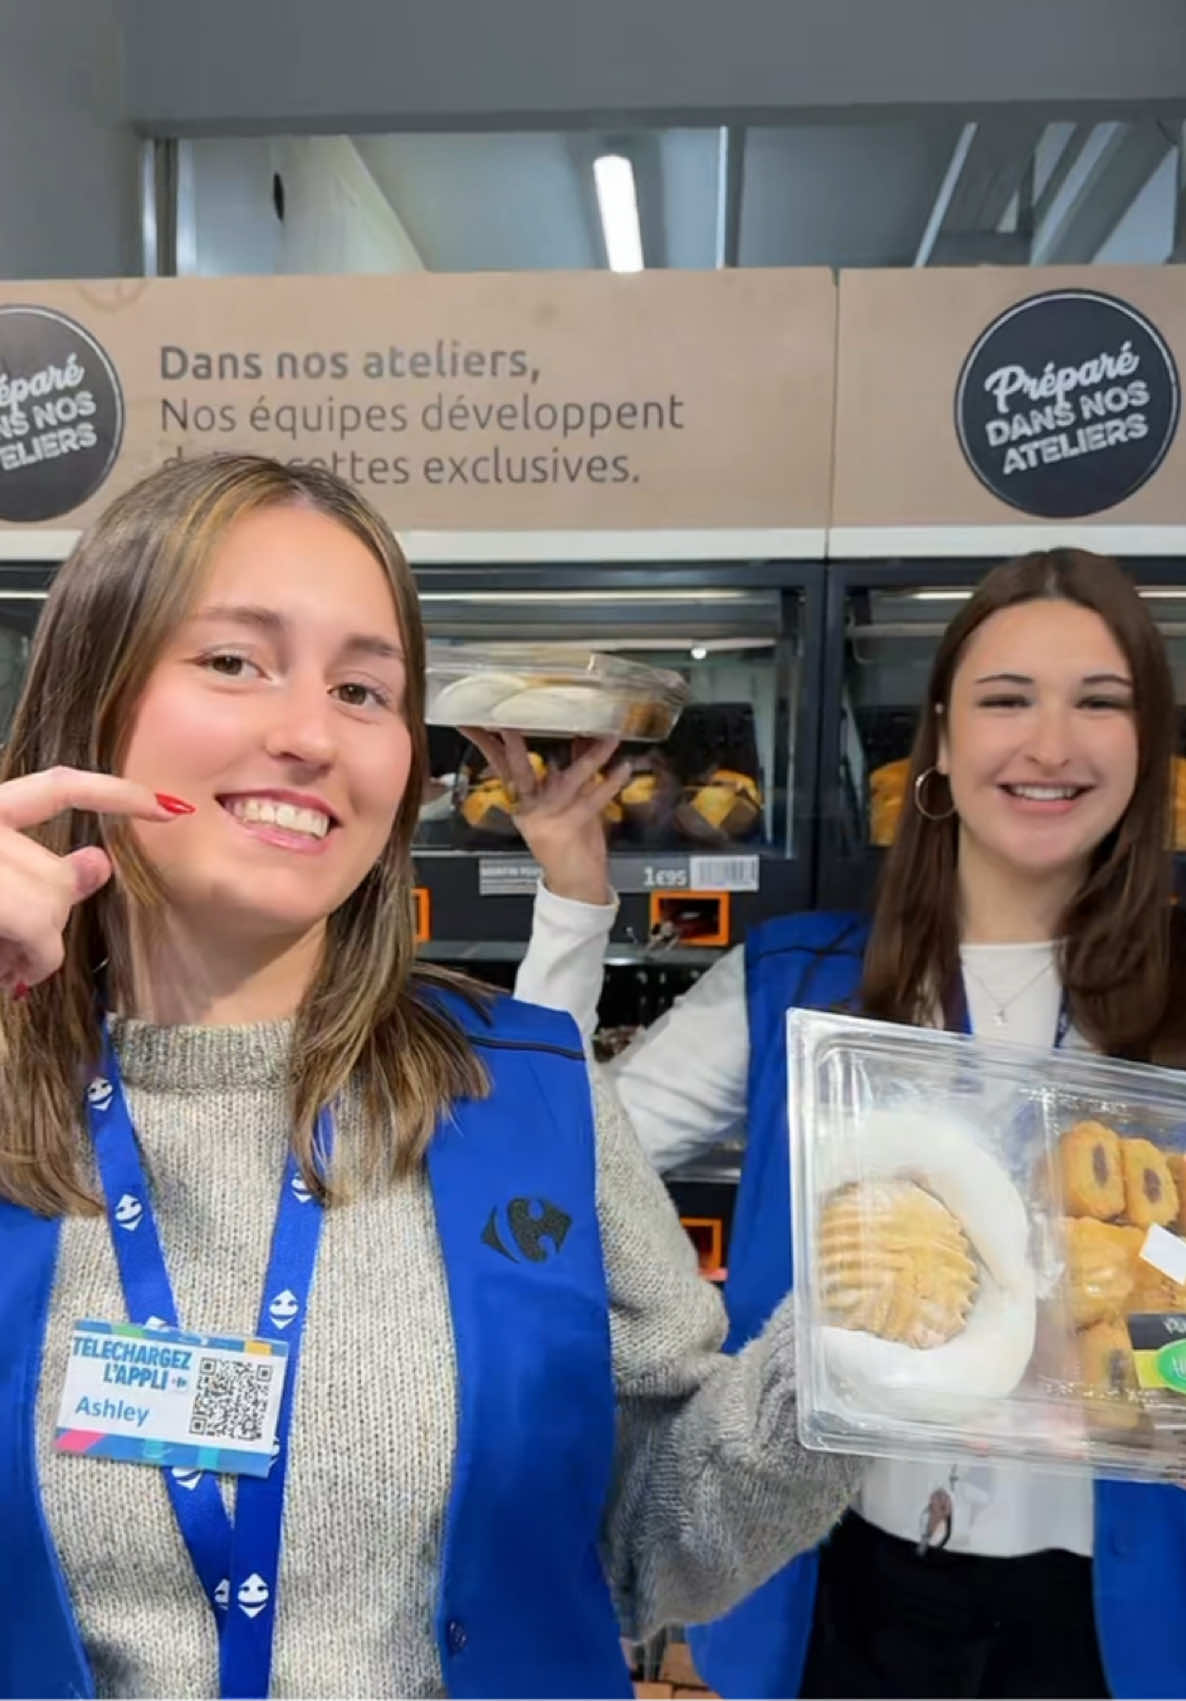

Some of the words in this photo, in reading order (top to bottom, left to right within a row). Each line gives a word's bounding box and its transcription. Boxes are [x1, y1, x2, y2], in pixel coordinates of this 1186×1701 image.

[159, 345, 263, 381] Dans
[276, 348, 349, 380] nos
[363, 340, 542, 385] ateliers,
[984, 341, 1140, 414] Préparé
[32, 390, 97, 430] NOS
[160, 398, 235, 434] Nos
[250, 394, 407, 449] équipes
[421, 393, 685, 447] développent
[985, 401, 1076, 447] DANS
[1079, 380, 1150, 420] NOS
[423, 446, 641, 485] exclusives.
[1002, 413, 1149, 475] ATELIERS
[102, 1362, 169, 1391] L'APPLI
[74, 1395, 151, 1427] Ashley
